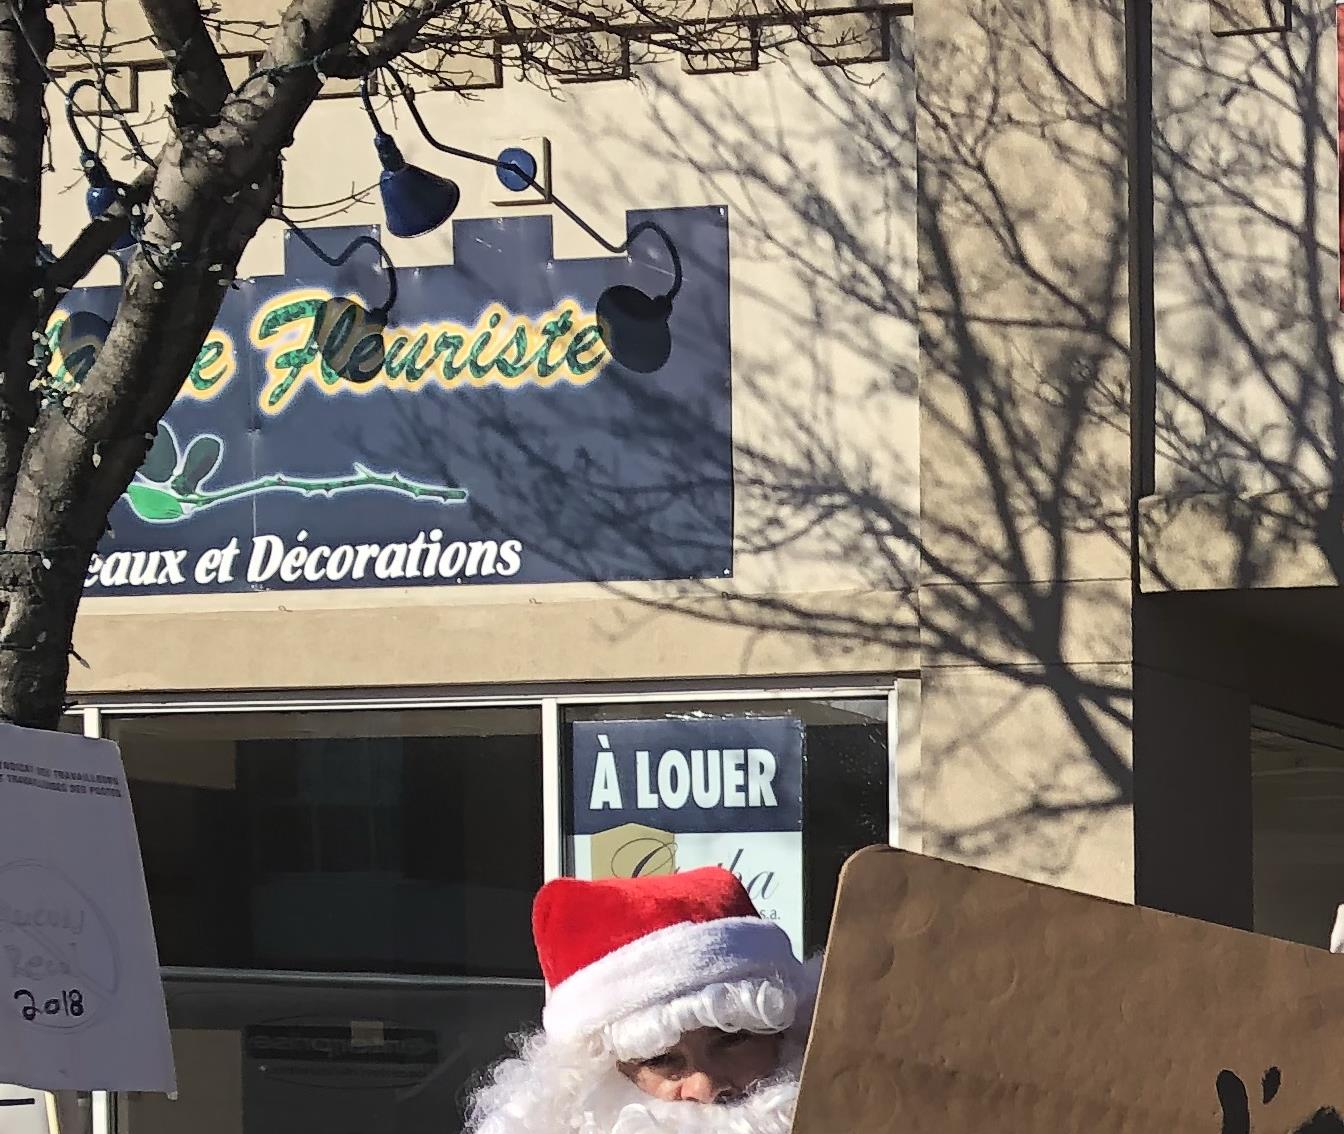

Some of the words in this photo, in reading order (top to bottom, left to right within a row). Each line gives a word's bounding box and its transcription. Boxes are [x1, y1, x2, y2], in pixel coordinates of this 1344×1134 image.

[256, 293, 608, 411] Fleuriste
[194, 535, 240, 583] et
[247, 529, 523, 583] Décorations
[590, 734, 623, 810] À
[635, 748, 778, 809] LOUER
[14, 989, 84, 1021] 2018
